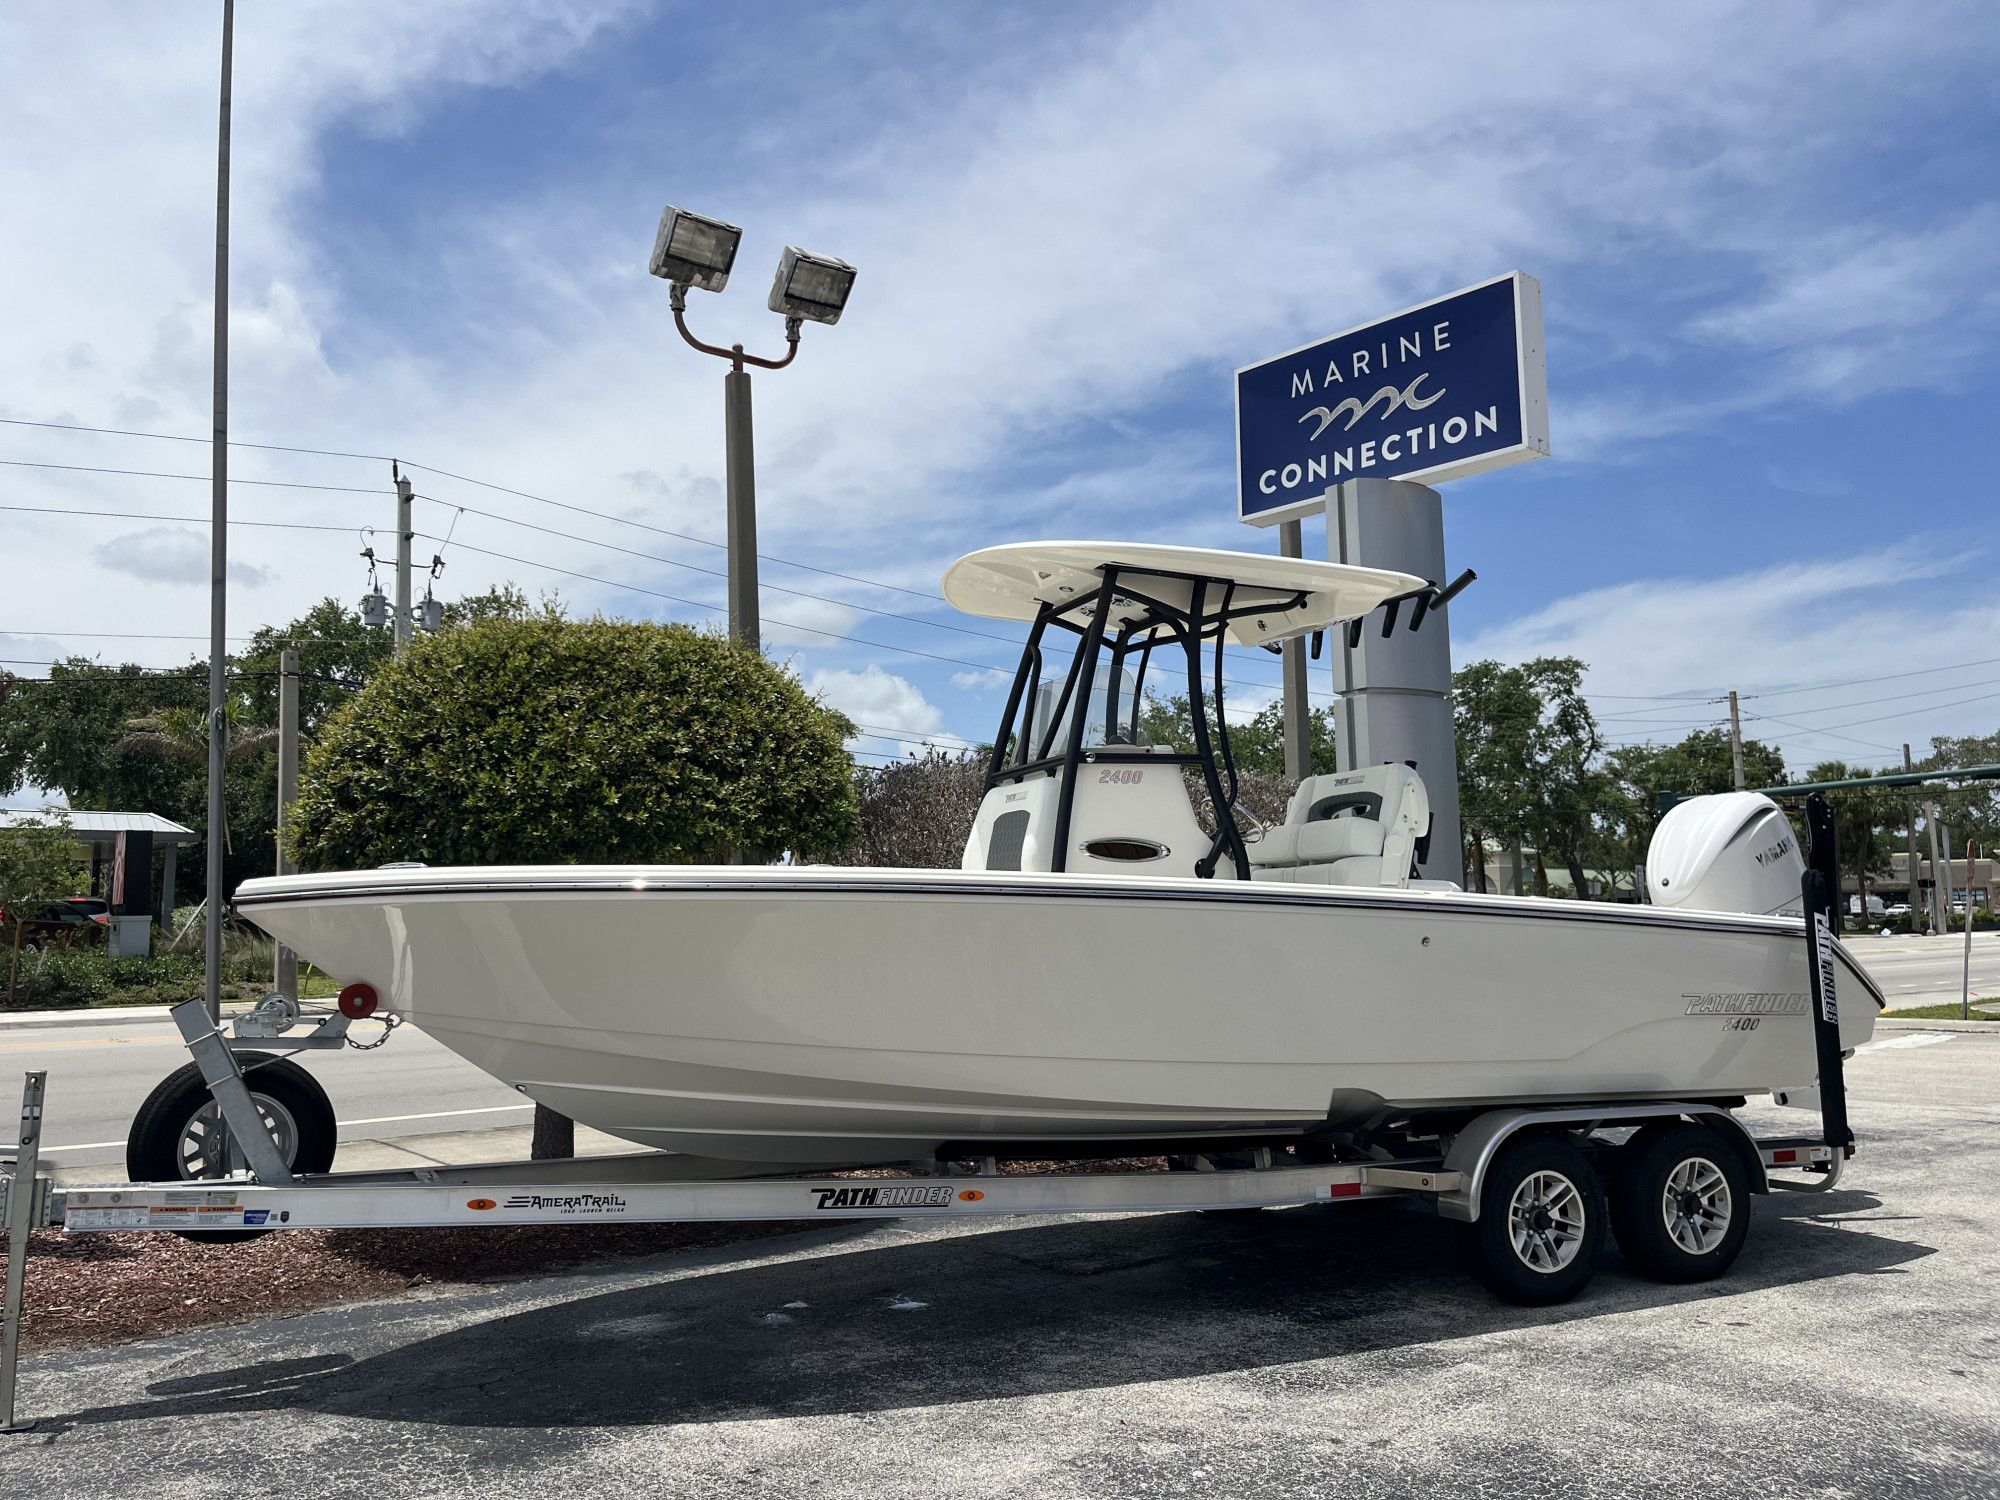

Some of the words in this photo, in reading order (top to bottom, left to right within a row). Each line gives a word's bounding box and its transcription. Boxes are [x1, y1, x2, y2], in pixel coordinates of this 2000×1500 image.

[1291, 321, 1451, 398] MARINE
[1259, 405, 1498, 495] CONNECTION
[1099, 769, 1144, 784] 2400
[1814, 906, 1838, 1025] PATHFINDER
[1681, 993, 1811, 1016] PATHFINDER
[1722, 1018, 1760, 1031] 2400
[811, 1186, 954, 1210] PATHFINDER
